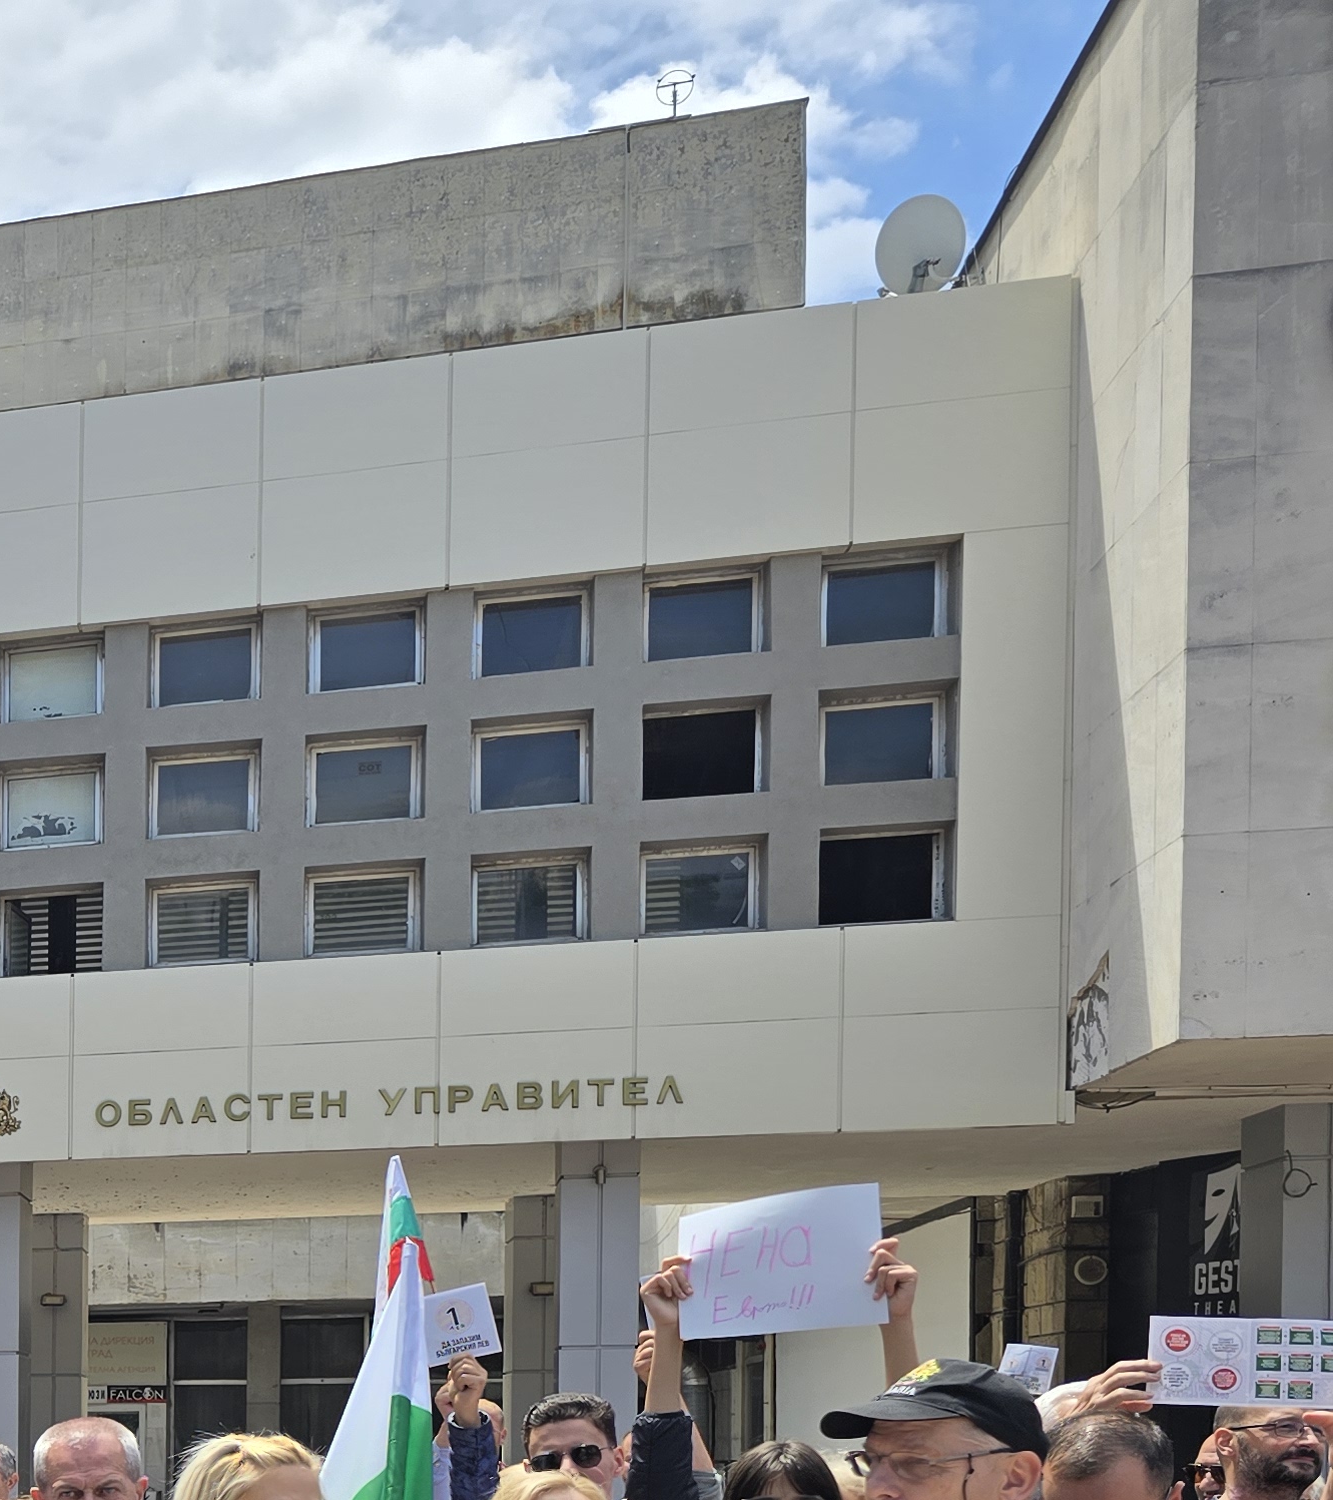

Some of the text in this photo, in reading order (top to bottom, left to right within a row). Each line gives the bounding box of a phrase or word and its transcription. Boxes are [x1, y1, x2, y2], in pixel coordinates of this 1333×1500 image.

[95, 1075, 684, 1127] ОБЛАСТЕН УПРАВИТЕЛ
[446, 1306, 459, 1326] 1
[109, 1387, 164, 1401] FALCON
